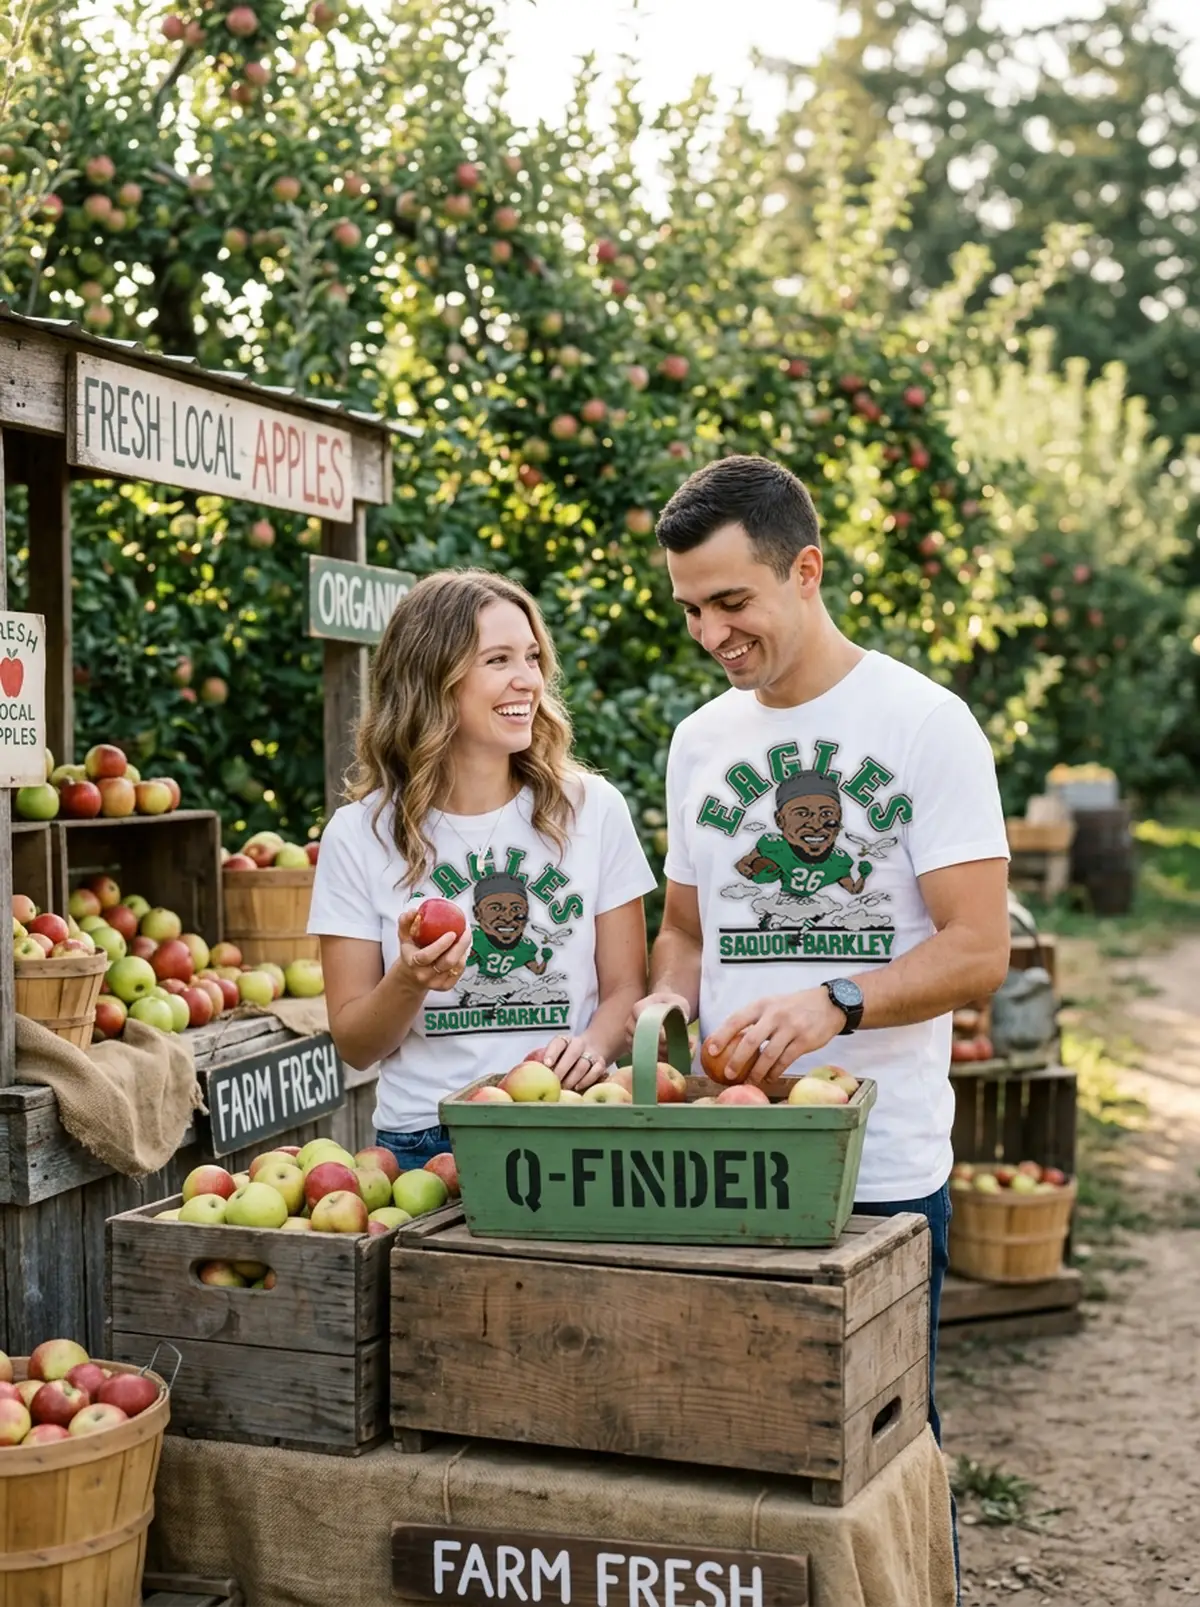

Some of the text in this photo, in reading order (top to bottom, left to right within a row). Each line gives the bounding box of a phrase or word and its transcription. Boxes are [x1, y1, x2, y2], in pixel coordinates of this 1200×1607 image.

[84, 376, 345, 510] FRESH LOCAL APPLES
[0, 620, 38, 653] RESH
[0, 703, 36, 721] OCAL
[0, 727, 37, 745] PLES
[696, 740, 913, 837] EAGLES
[407, 847, 584, 925] AGLES
[790, 867, 826, 892] 26
[719, 933, 895, 956] SAQUON BARKLEY
[486, 953, 515, 974] 26
[497, 1006, 570, 1027] BARKLEY
[216, 1043, 340, 1142] FARM FRESH
[505, 1147, 790, 1212] Q-FINDER
[433, 1540, 763, 1607] FARM FRESH
